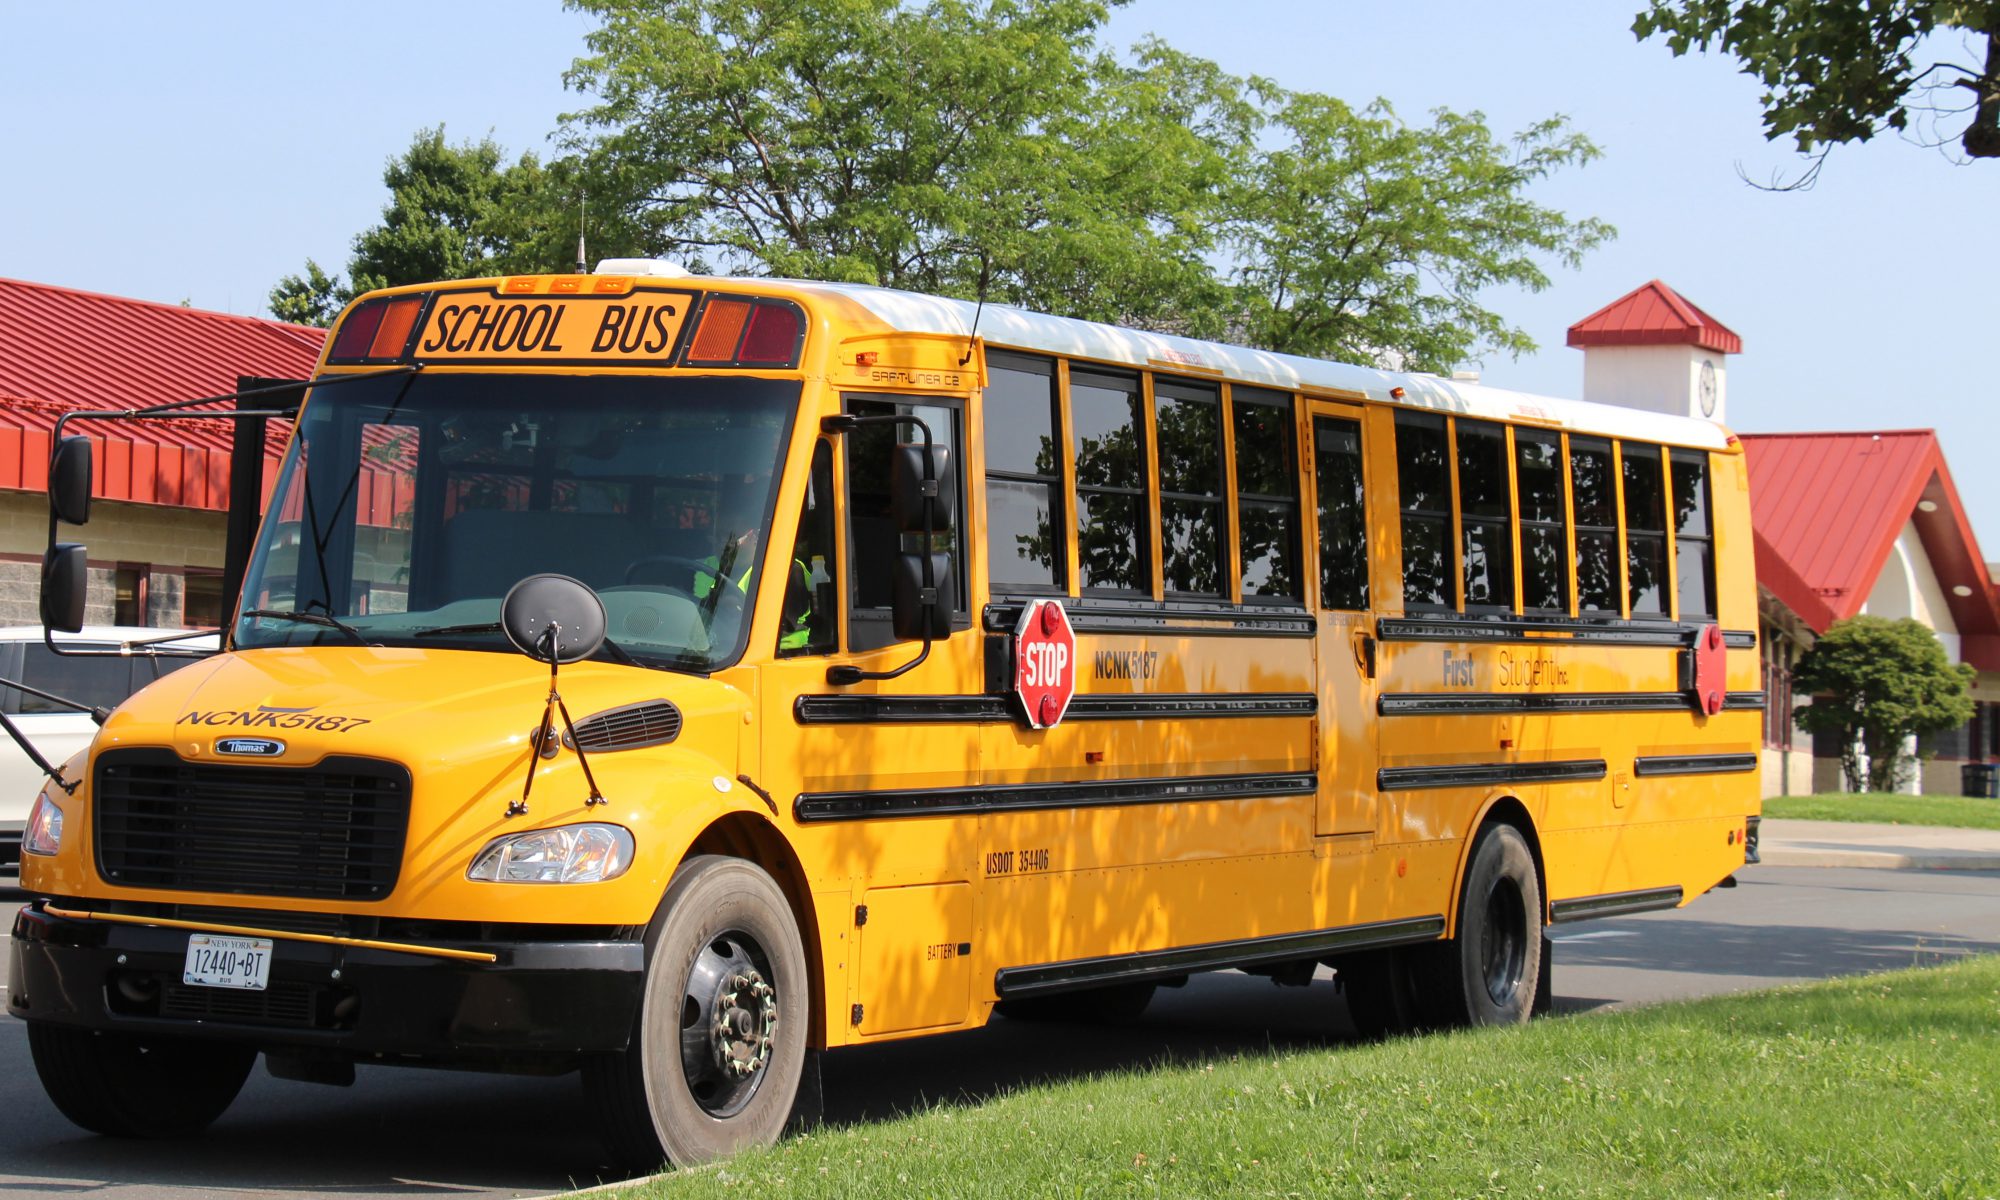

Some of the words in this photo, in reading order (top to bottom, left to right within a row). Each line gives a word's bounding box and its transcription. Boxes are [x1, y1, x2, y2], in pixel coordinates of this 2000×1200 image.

[424, 304, 566, 352] SCHOOL
[591, 305, 676, 353] BUS
[1026, 642, 1068, 687] STOP
[1095, 651, 1158, 679] NCNK5187
[1443, 650, 1474, 686] First
[1499, 650, 1555, 686] Student
[176, 711, 371, 733] NCNK5187
[227, 740, 270, 753] Thomas
[986, 851, 1014, 875] USDOT
[1018, 849, 1049, 872] 354406
[211, 940, 228, 948] NEW
[231, 941, 252, 950] YORK
[927, 943, 957, 961] BATTERY
